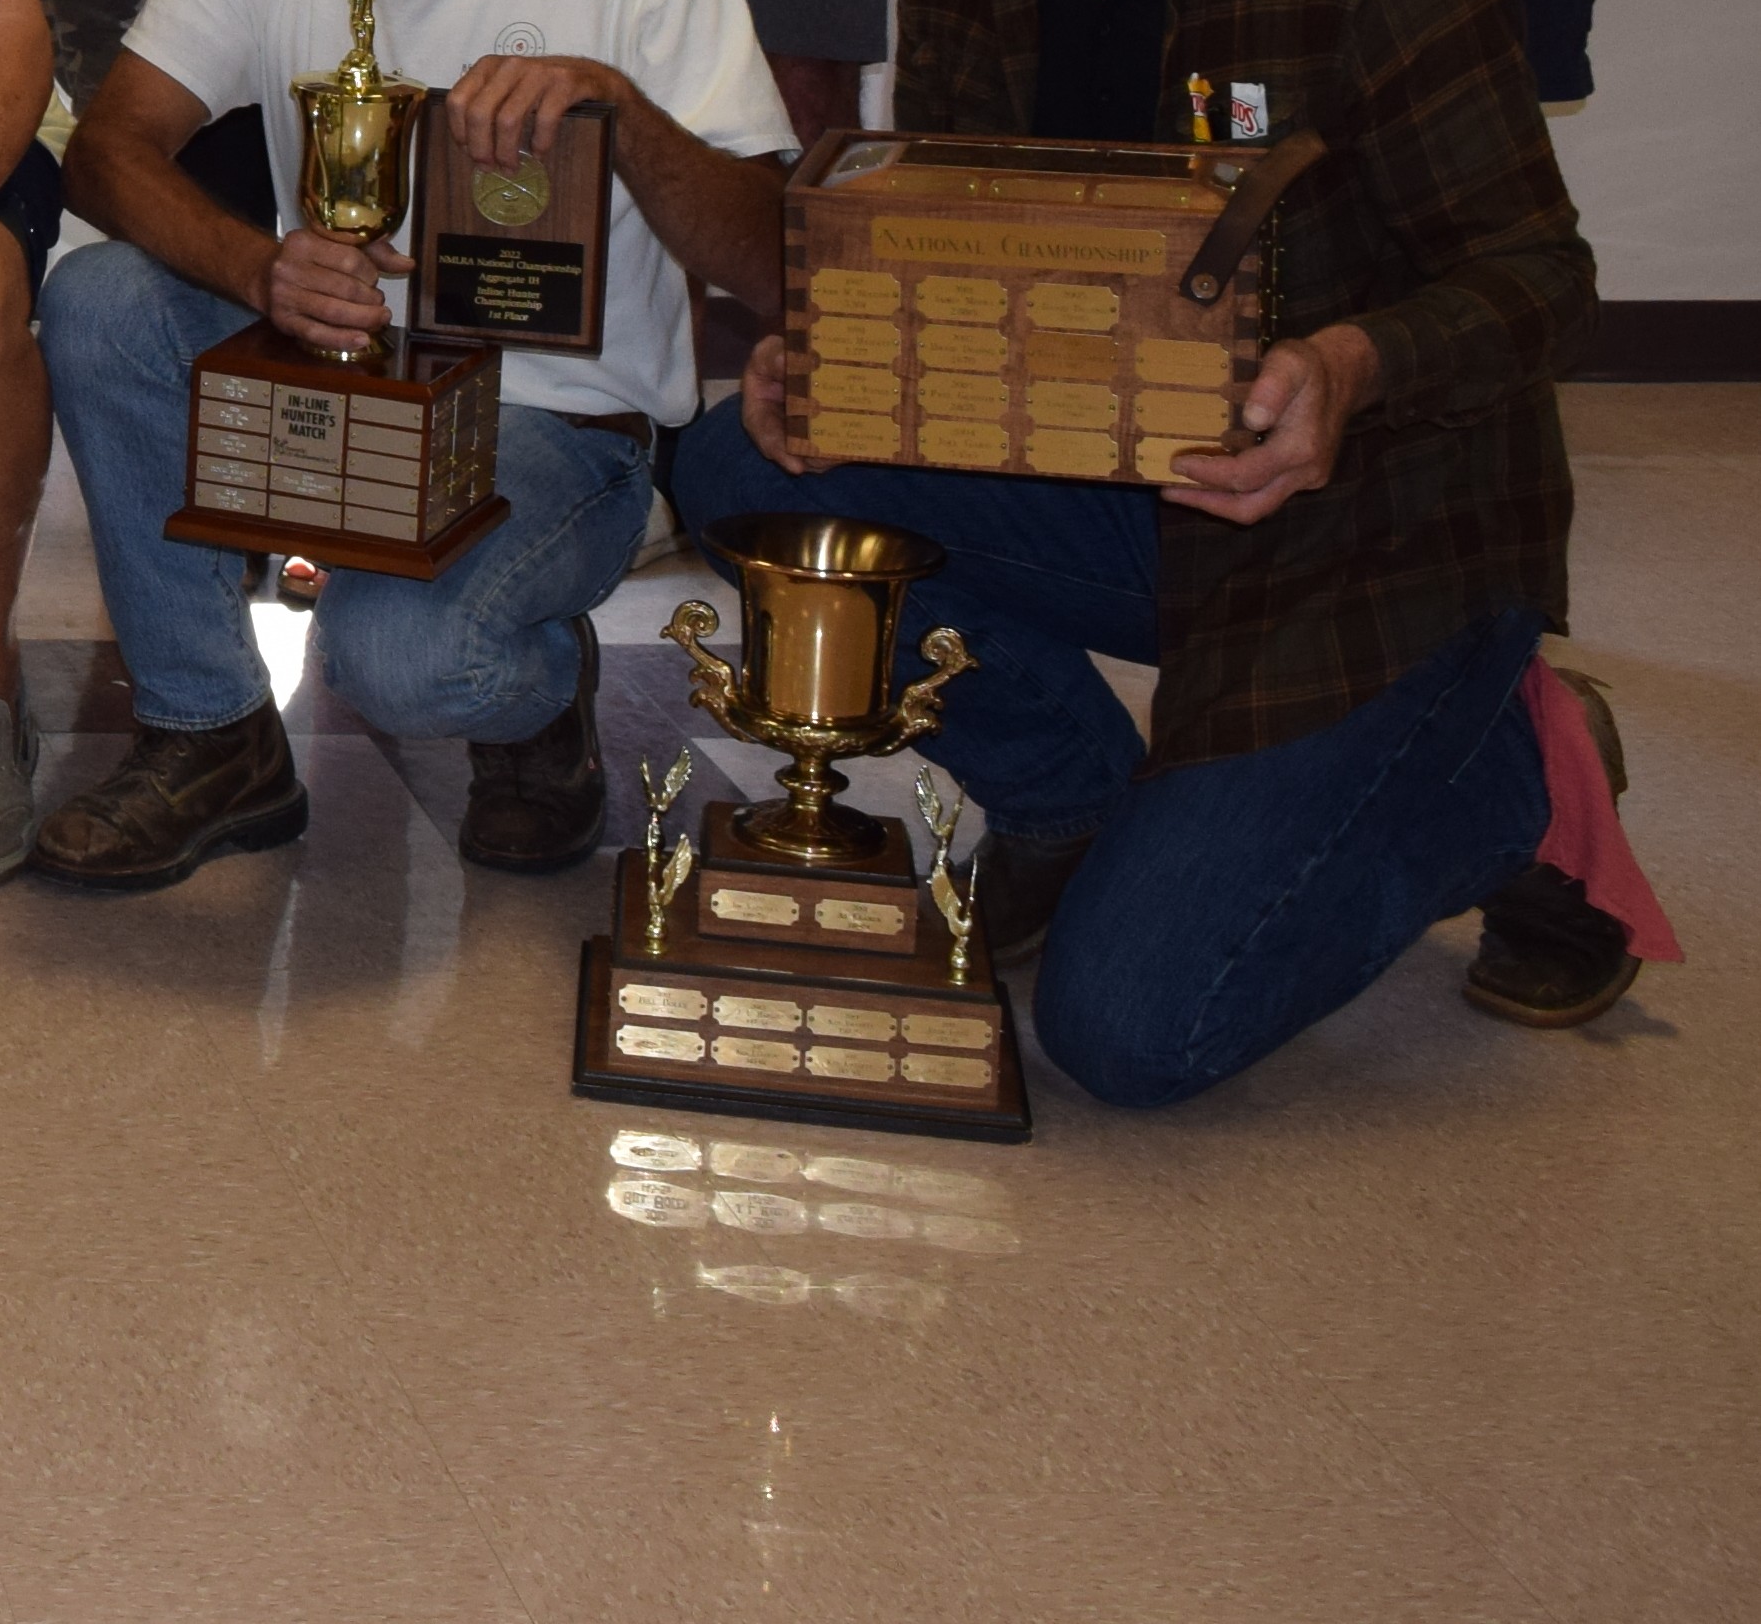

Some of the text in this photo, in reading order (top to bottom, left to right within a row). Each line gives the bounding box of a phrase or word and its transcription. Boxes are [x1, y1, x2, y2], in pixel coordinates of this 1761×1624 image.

[879, 228, 1150, 264] NATIONAL CHAMPIONSHIP
[499, 250, 521, 259] 2022
[438, 255, 582, 275] NMLRA National Championship
[479, 273, 526, 285] Aggregate
[476, 287, 541, 299] Inline Hunter
[474, 296, 543, 311] Championship
[488, 310, 530, 321] 1st Place
[287, 393, 331, 413] IN-LINE
[280, 407, 336, 428] HUNTER'S
[288, 423, 327, 440] MATCH
